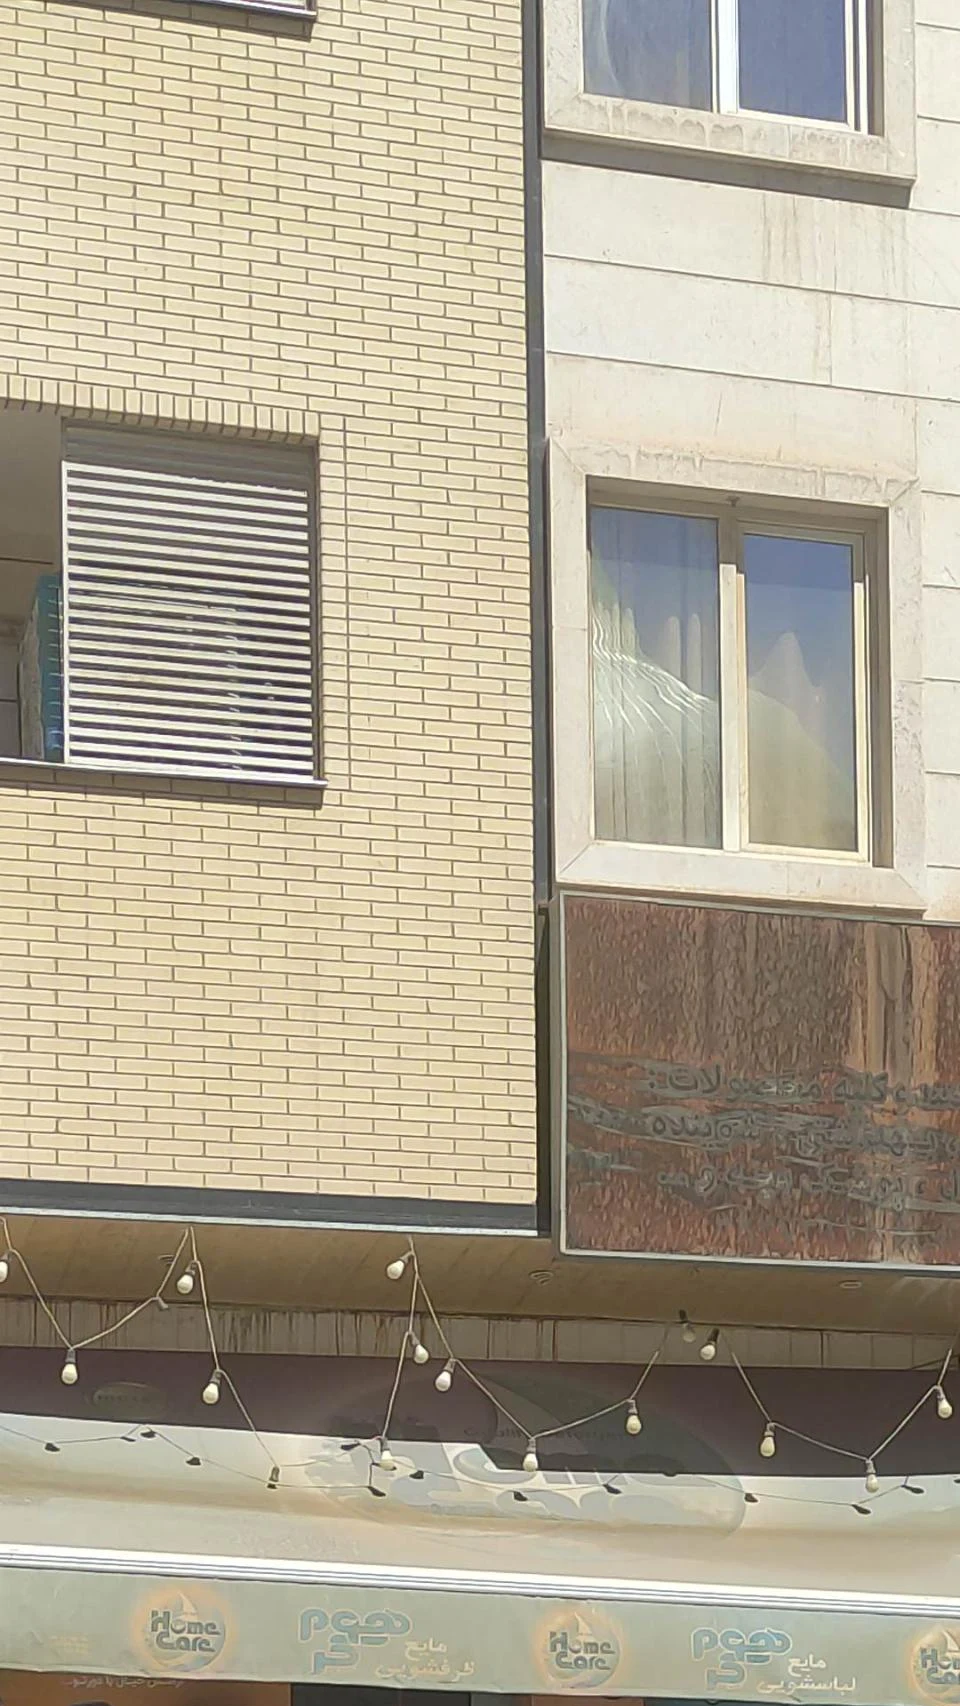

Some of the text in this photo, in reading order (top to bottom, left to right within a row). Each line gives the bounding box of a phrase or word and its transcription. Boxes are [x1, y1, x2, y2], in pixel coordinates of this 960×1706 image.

[150, 1609, 220, 1635] Home
[155, 1632, 216, 1652] Care
[549, 1630, 616, 1656] Home
[555, 1651, 611, 1671] Care
